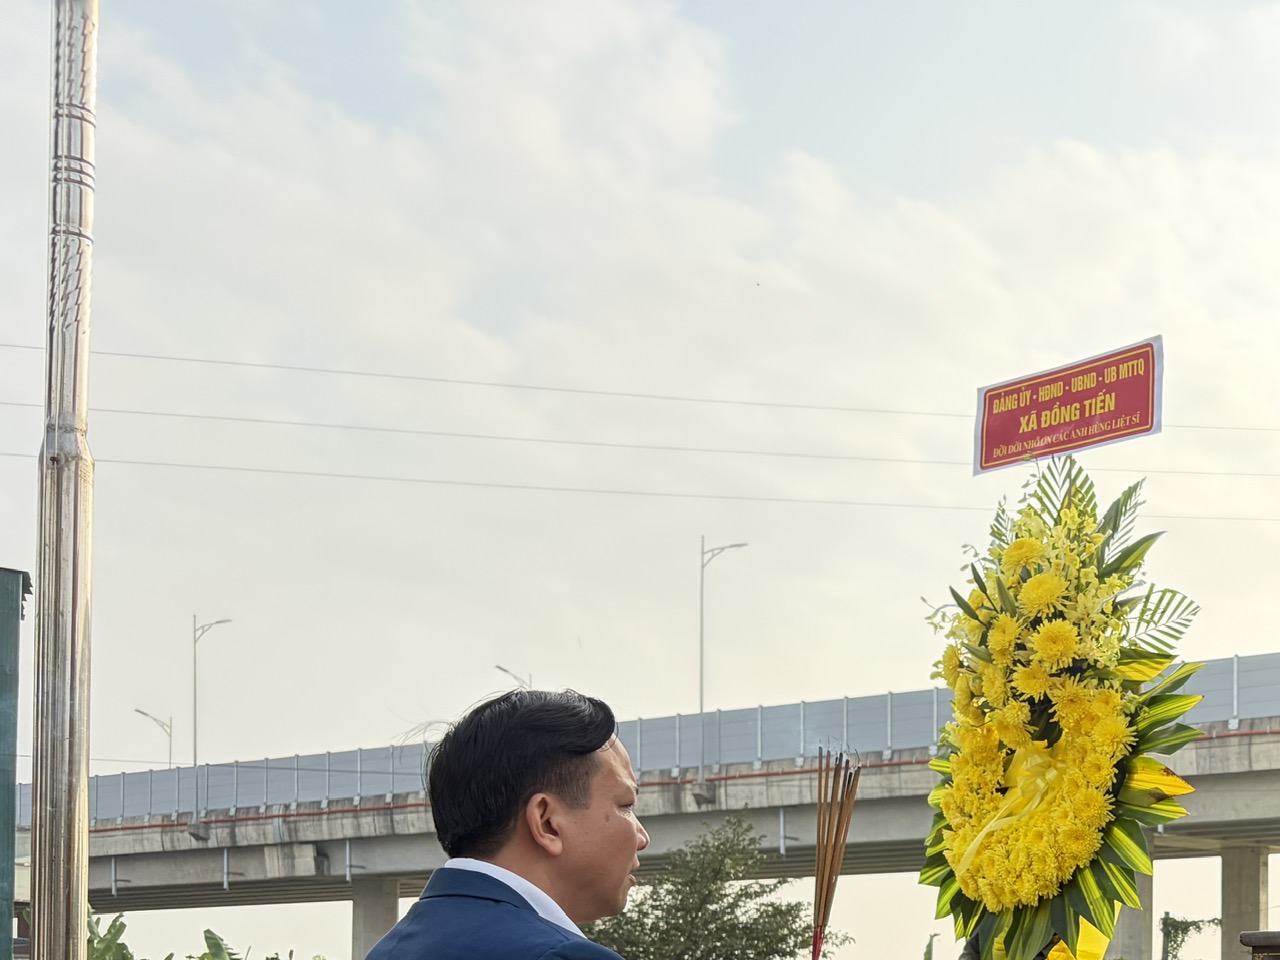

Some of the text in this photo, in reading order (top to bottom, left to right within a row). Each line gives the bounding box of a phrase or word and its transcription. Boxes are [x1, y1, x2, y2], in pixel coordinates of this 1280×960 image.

[993, 391, 1018, 414] ĐẢNG
[1019, 384, 1032, 408] ỦY
[1038, 381, 1064, 403] HĐND
[1071, 372, 1097, 393] UBND
[1104, 366, 1117, 384] UB
[1119, 358, 1145, 379] MTTQ
[1018, 389, 1116, 434] XÃ ĐỒNG TIẾN
[1053, 431, 1069, 445] CÁC
[1070, 427, 1088, 440] ANH
[1088, 421, 1111, 436] HÙNG
[1112, 414, 1132, 430] LIỆT
